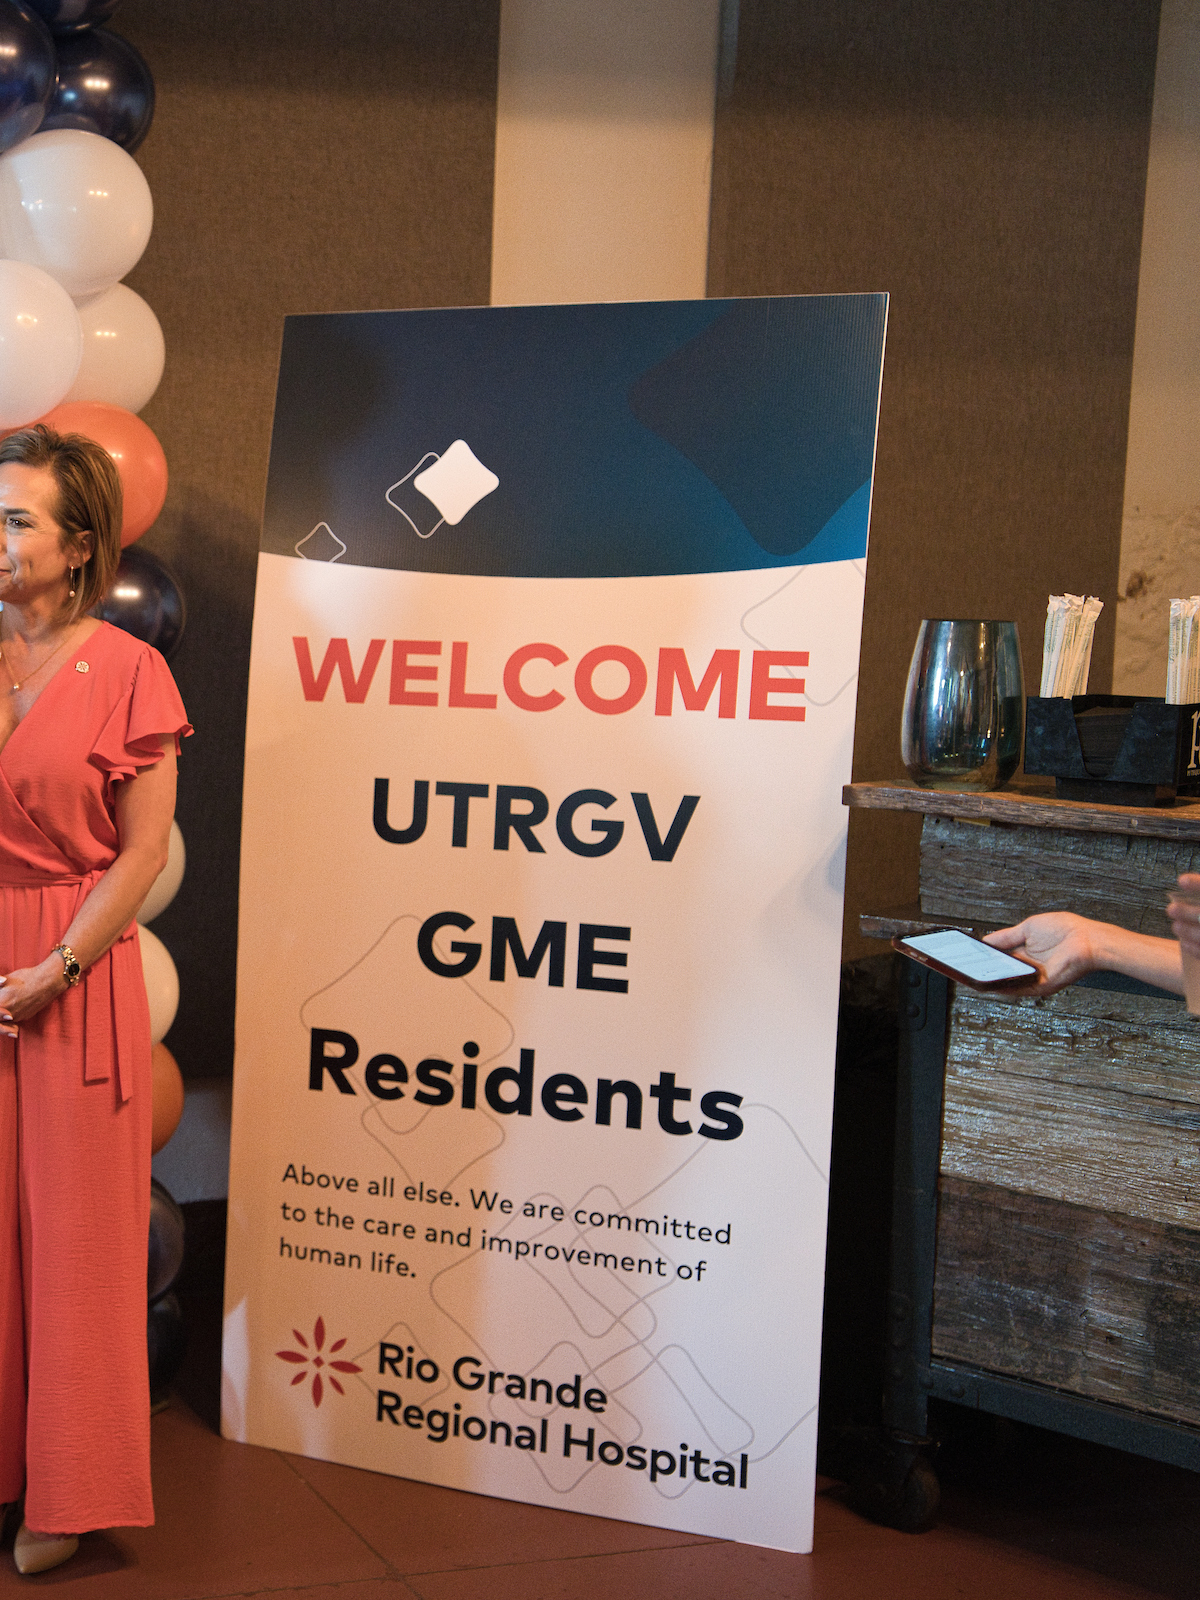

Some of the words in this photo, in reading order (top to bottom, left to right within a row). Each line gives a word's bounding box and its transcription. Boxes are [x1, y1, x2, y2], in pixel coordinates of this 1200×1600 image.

[291, 635, 810, 722] WELCOME
[372, 777, 701, 862] UTRGV
[417, 911, 632, 994] GME
[308, 1027, 744, 1141] Residents
[280, 1202, 306, 1223] to
[314, 1206, 355, 1230] the
[363, 1218, 416, 1240] care
[425, 1227, 471, 1248] and
[481, 1229, 667, 1277] improvement
[676, 1260, 707, 1282] of
[282, 1163, 359, 1193] Above
[367, 1176, 395, 1198] all
[403, 1181, 460, 1207] else.
[469, 1188, 513, 1214] We
[523, 1202, 565, 1222] are
[574, 1210, 731, 1245] committed
[279, 1236, 362, 1269] human
[371, 1251, 416, 1278] life.
[378, 1341, 440, 1384] Rio
[452, 1356, 608, 1414] Grande
[376, 1388, 549, 1454] Regional
[563, 1423, 749, 1489] Hospital
